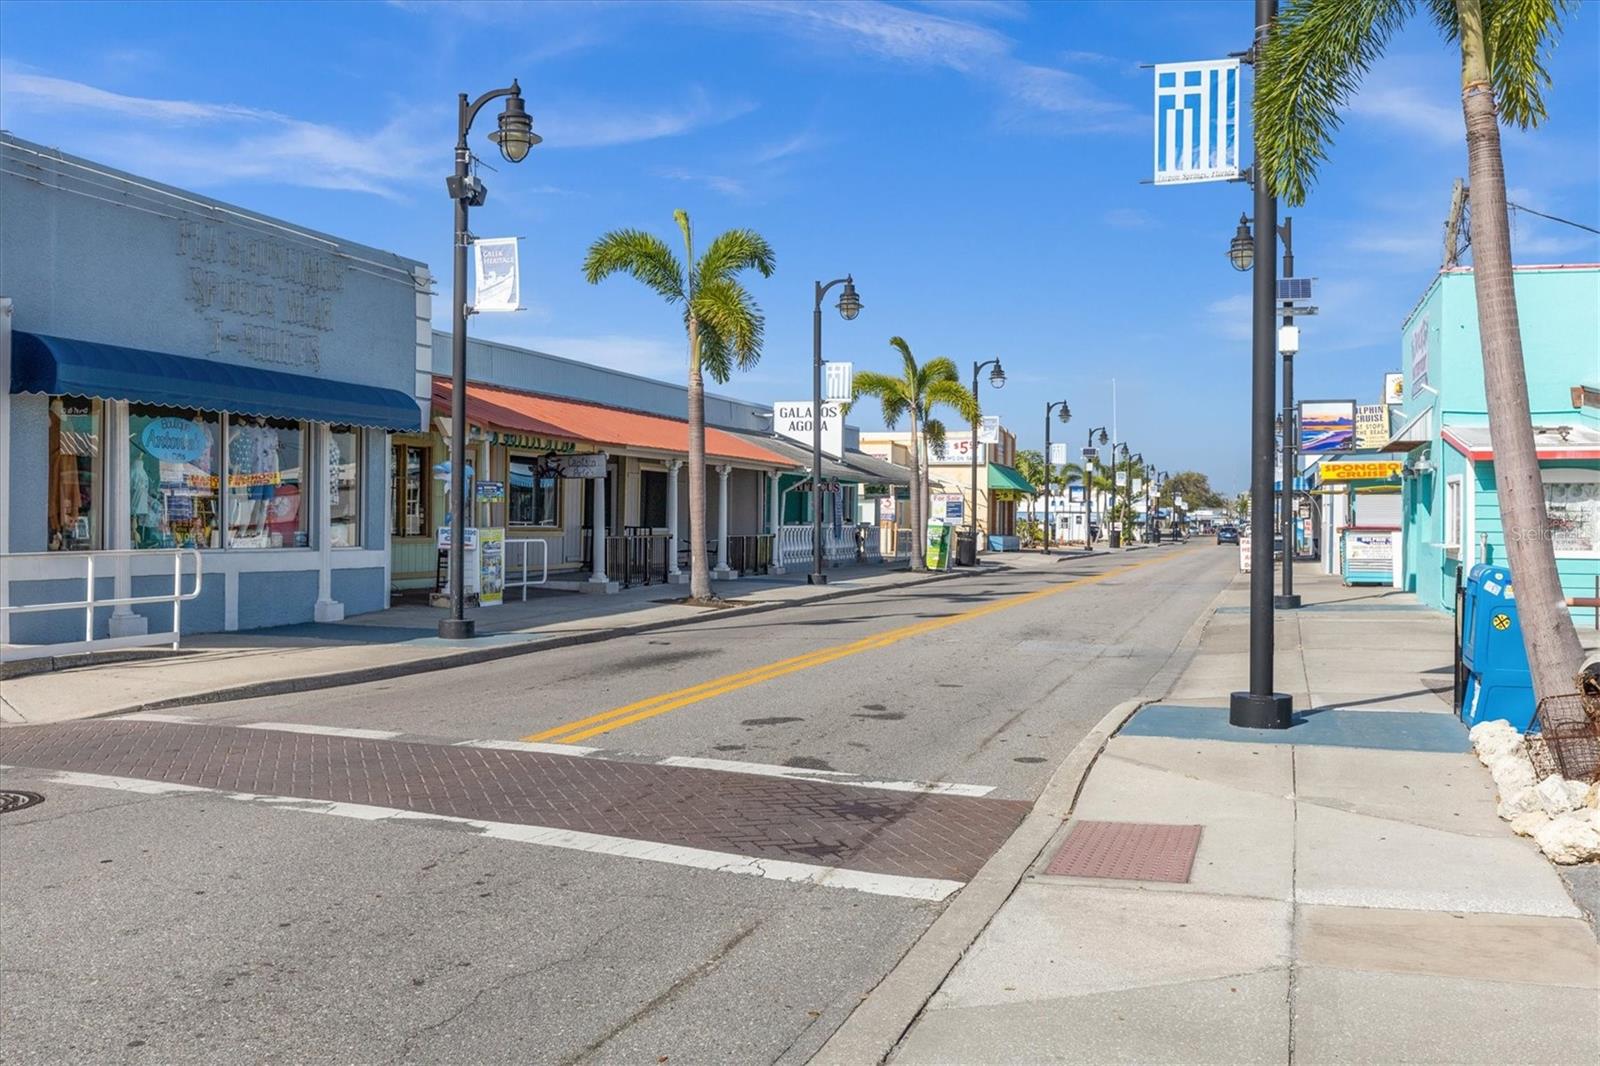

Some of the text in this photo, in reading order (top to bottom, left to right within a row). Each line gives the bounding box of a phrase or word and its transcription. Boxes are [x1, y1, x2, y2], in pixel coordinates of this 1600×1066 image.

[779, 407, 838, 418] GALAOS
[1356, 405, 1384, 414] LPHIN
[788, 420, 829, 432] AGOA
[1325, 463, 1402, 473] SPONGEO
